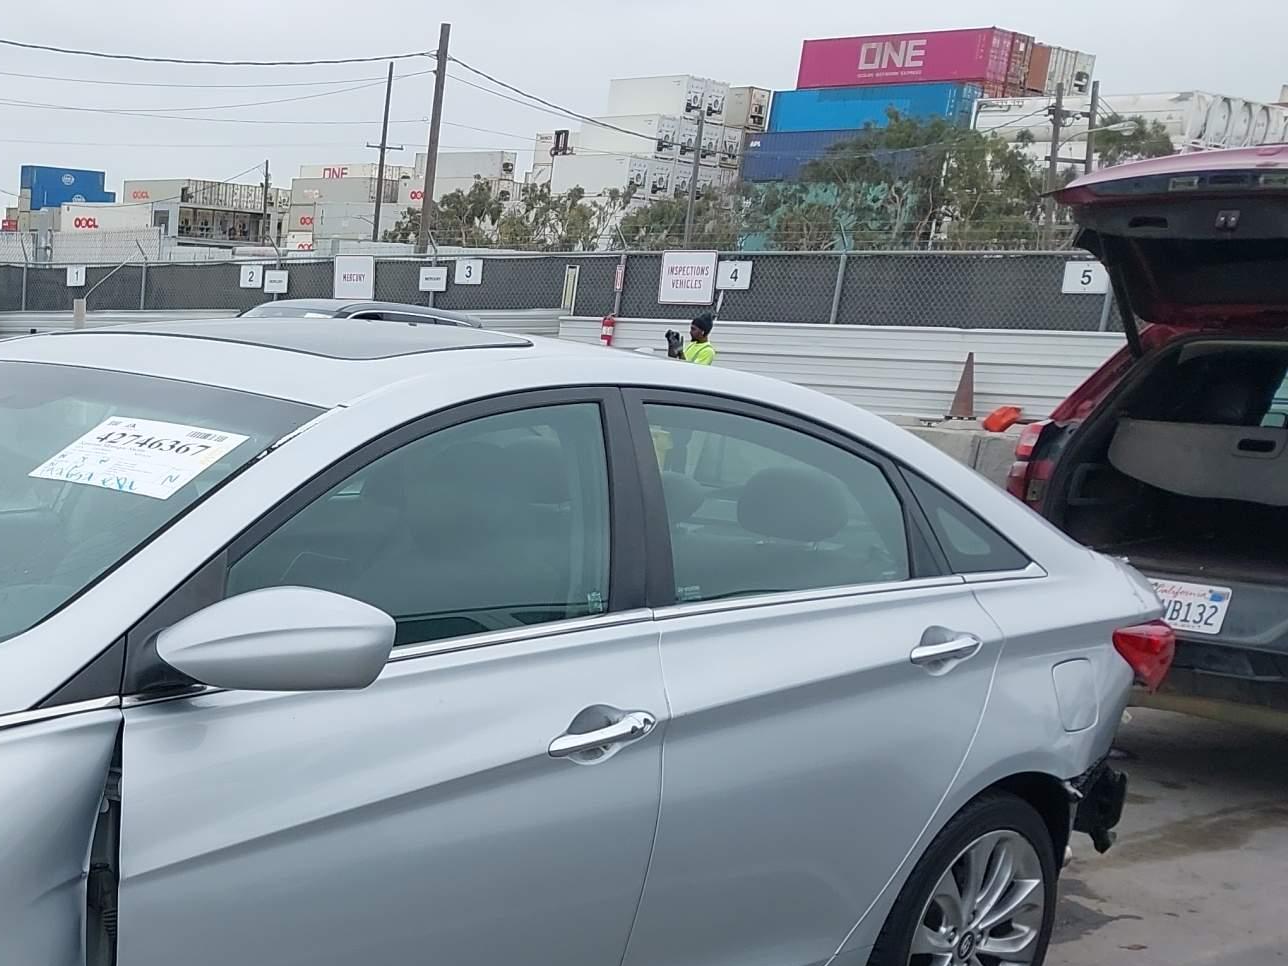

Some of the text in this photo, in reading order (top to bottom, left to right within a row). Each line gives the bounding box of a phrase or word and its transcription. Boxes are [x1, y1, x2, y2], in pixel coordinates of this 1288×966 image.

[858, 40, 927, 69] ONE
[132, 191, 150, 199] OOCL
[74, 217, 99, 229] OOCL
[74, 271, 80, 281] 1
[248, 270, 255, 282] 2
[465, 265, 472, 279] 3
[667, 265, 710, 276] INSPECTIONS
[729, 268, 739, 282] 4
[342, 273, 366, 283] MERCURY
[1080, 269, 1093, 285] 5
[671, 279, 703, 289] VEHICLES
[96, 431, 211, 456] 42746367
[1154, 583, 1208, 598] California
